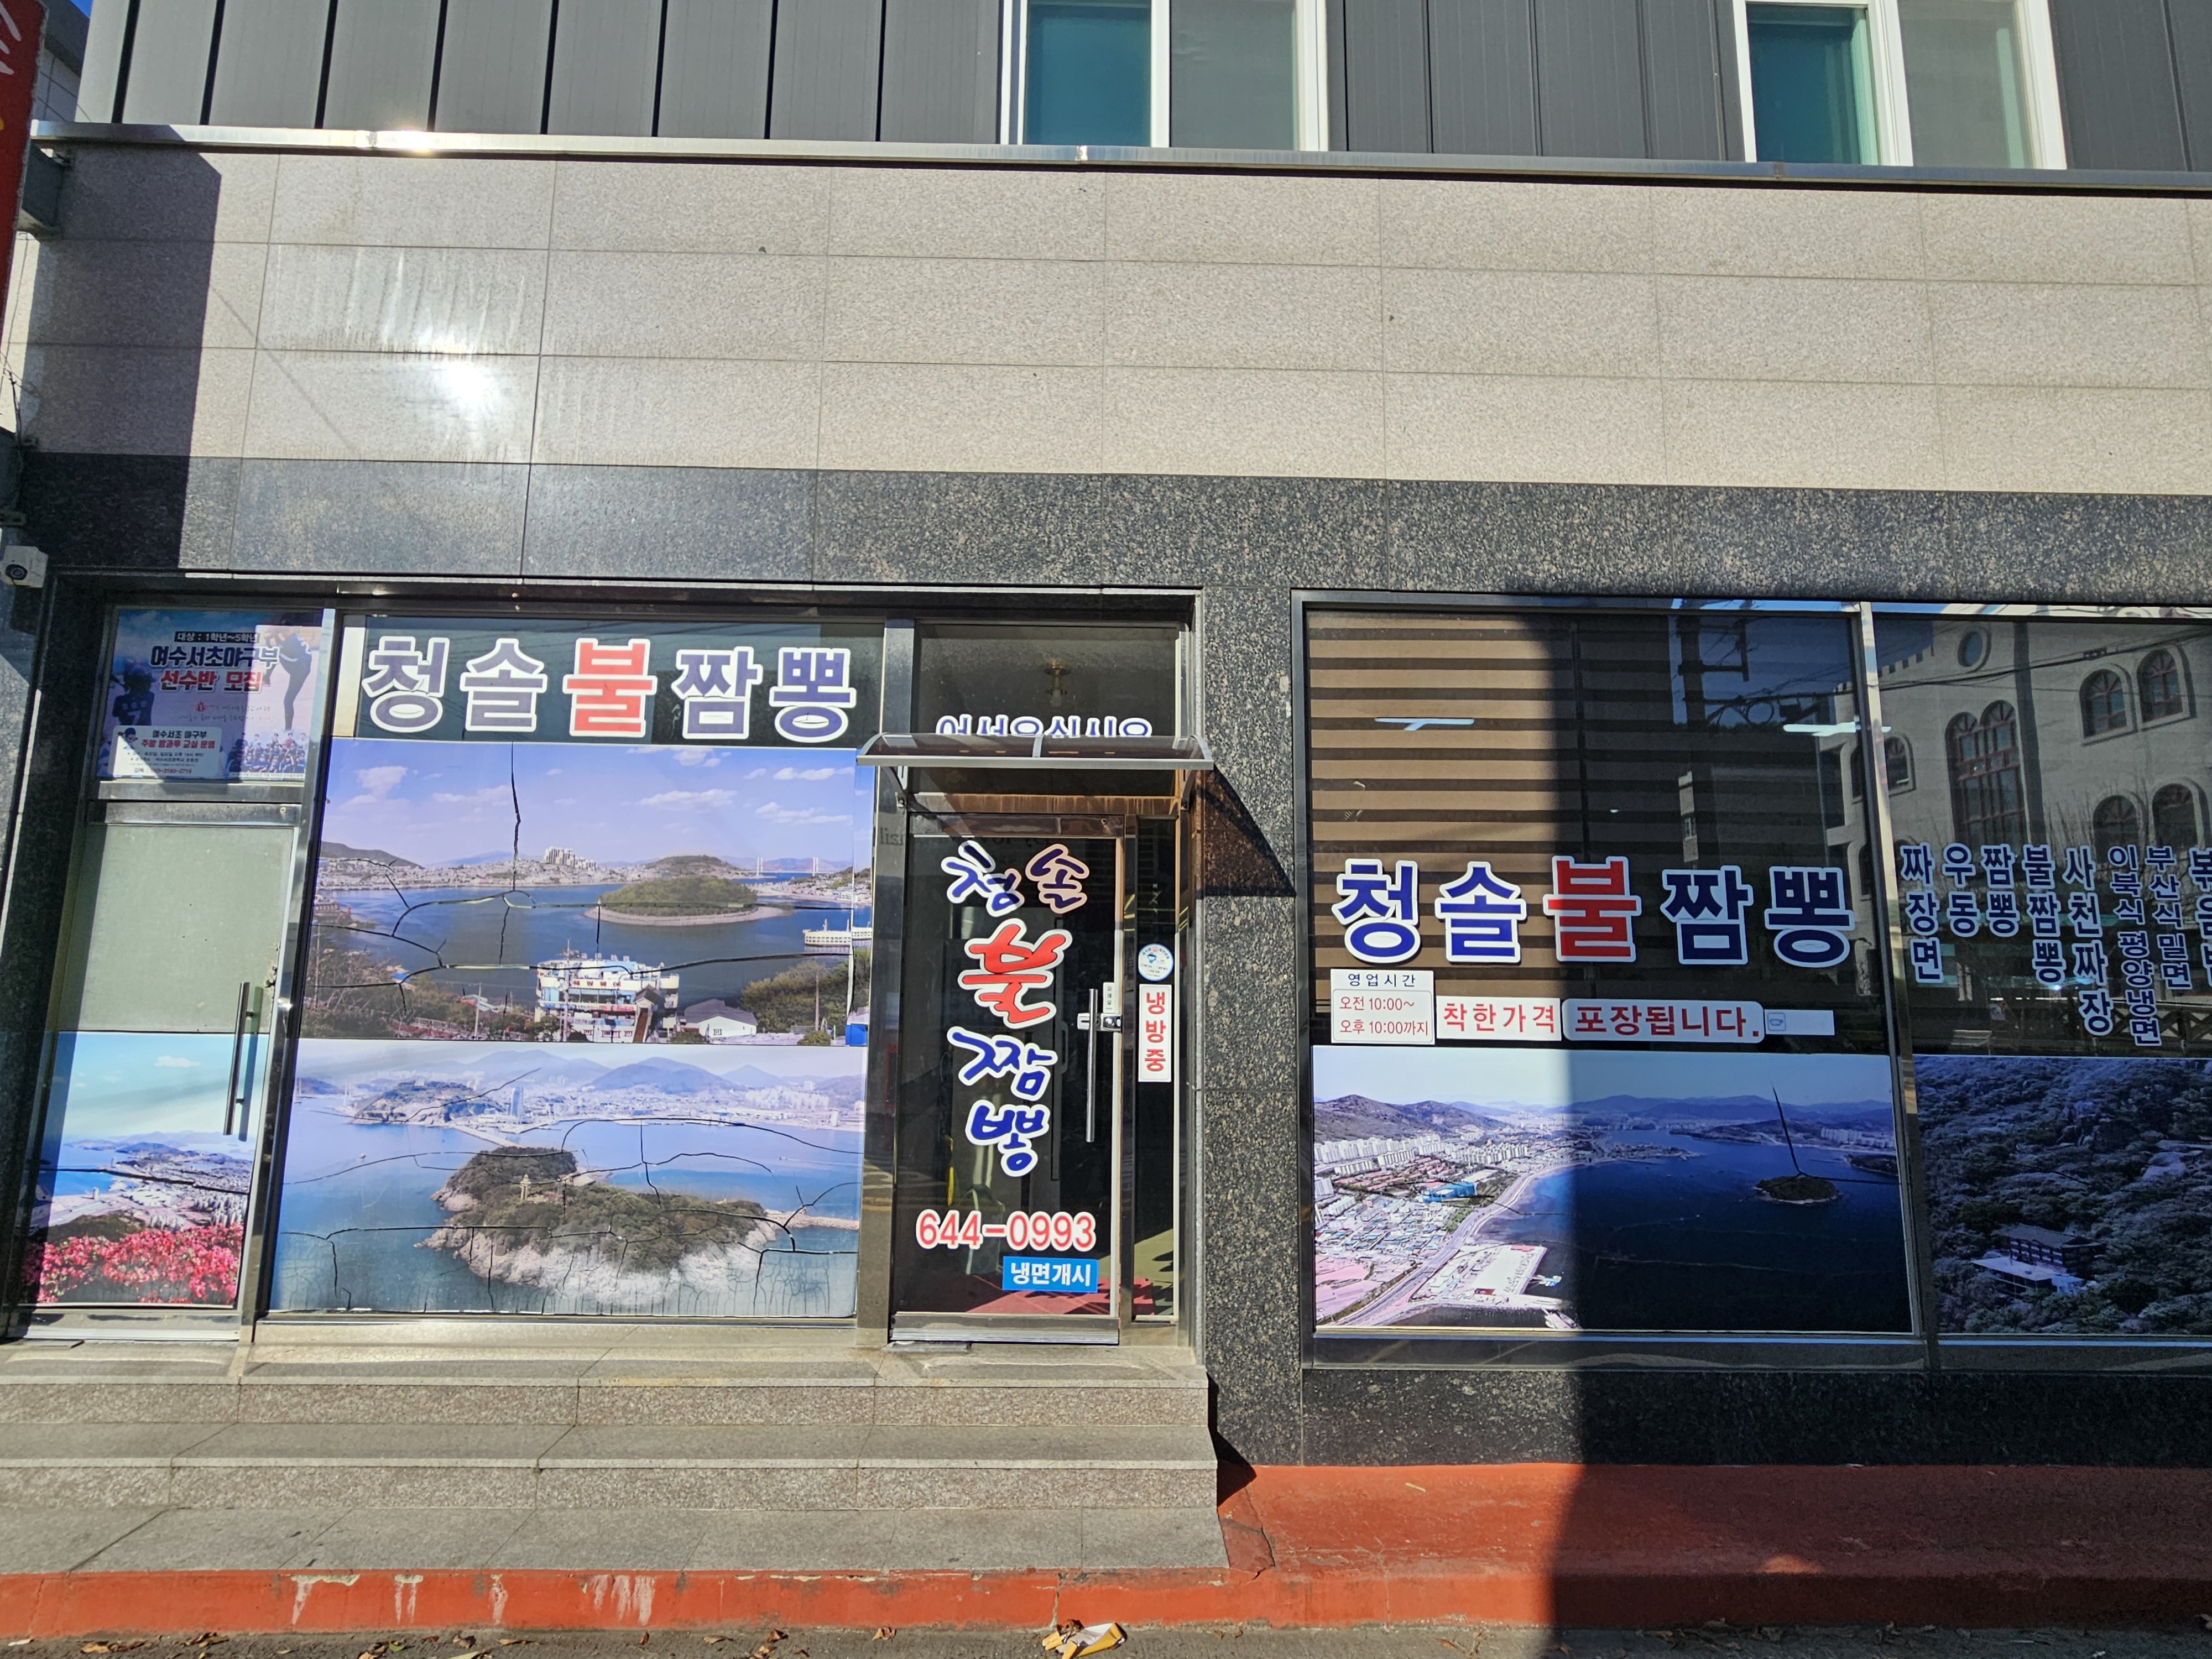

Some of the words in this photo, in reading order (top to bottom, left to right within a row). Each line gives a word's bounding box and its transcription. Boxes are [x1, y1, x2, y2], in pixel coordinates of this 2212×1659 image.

[150, 645, 280, 669] 여수서초야구부
[178, 633, 194, 641] 대상
[160, 670, 218, 691] 선수반
[223, 671, 263, 692] 모집
[362, 636, 857, 743] 청솔불짬뽕
[1332, 855, 1855, 969] 청솔불짬뽕
[1900, 843, 1944, 983] 짜장면
[1942, 843, 1980, 937] 우동
[1981, 843, 2019, 937] 짬뽕
[2022, 844, 2067, 984] 불짬뽕
[2107, 844, 2145, 925] 이북식
[2145, 845, 2183, 930] 부산식
[2062, 844, 2114, 1035] 사천짜장
[2157, 933, 2193, 990] 밀면
[1339, 997, 1365, 1011] 오전
[1369, 998, 1415, 1011] 10:00~
[1347, 973, 1416, 988] 영업시간
[2117, 930, 2162, 1046] 평양냉면
[1144, 992, 1166, 1072] 냉방중
[1339, 1020, 1365, 1035] 오후
[1369, 1020, 1428, 1036] 10:00까지
[1443, 1002, 1555, 1034] 착한가격
[1575, 1005, 1760, 1037] 포장됩니다.
[916, 1209, 1097, 1252] 644-0993
[1010, 1262, 1092, 1287] 냉면개시
